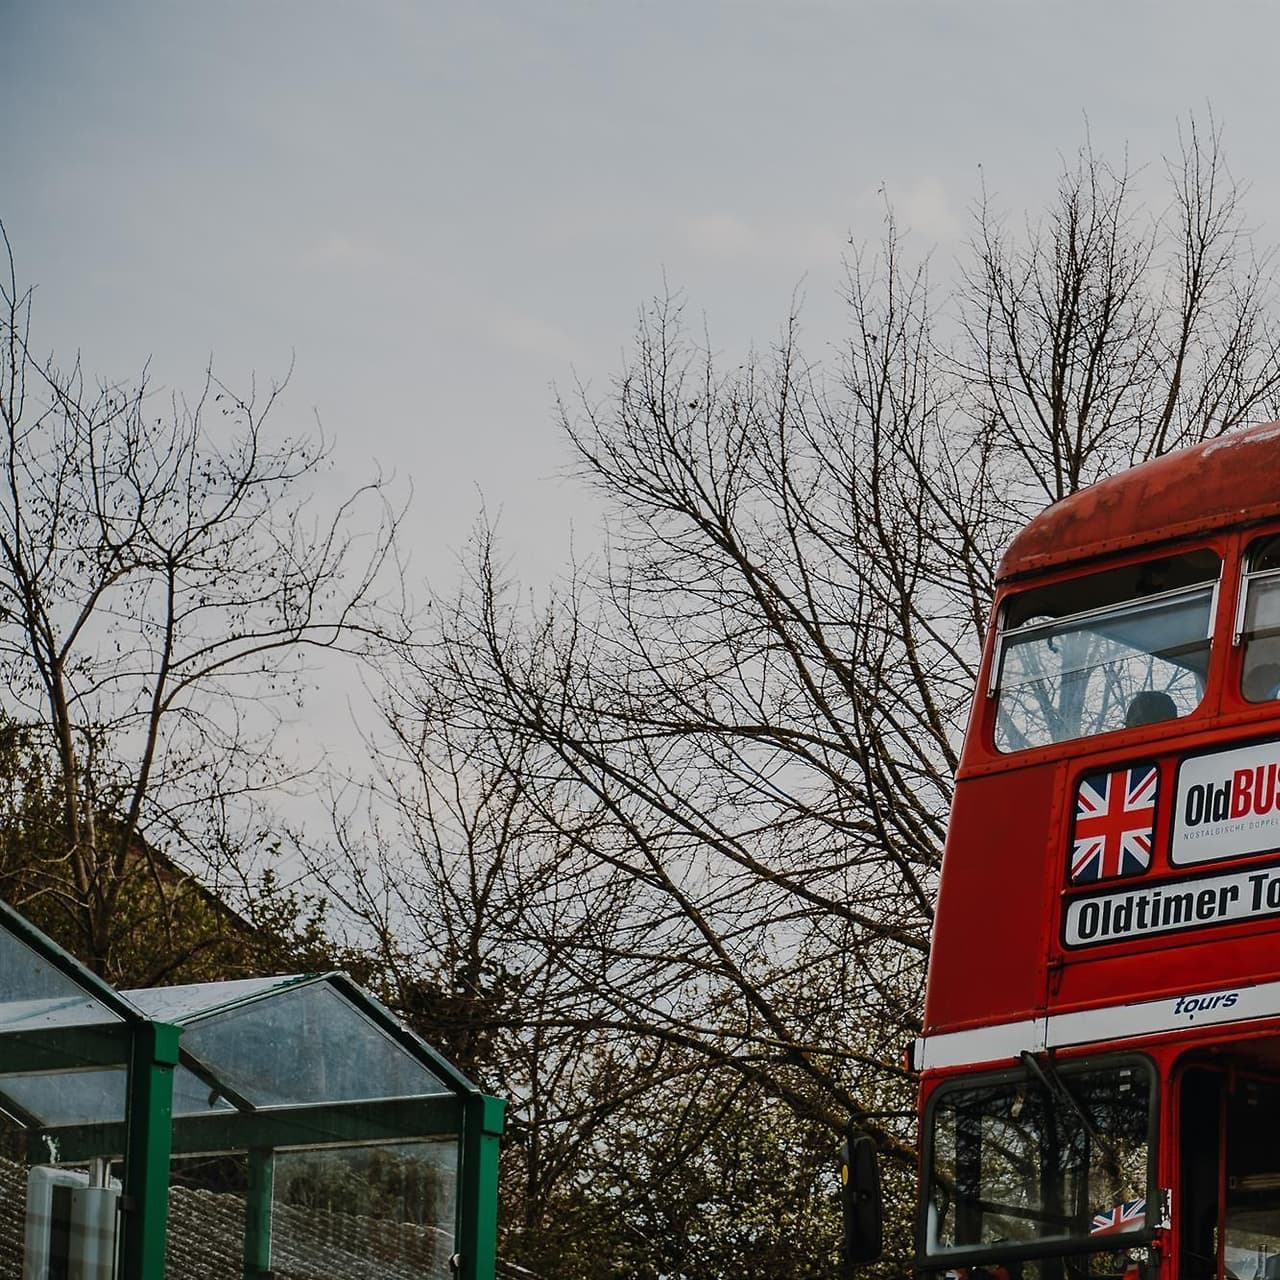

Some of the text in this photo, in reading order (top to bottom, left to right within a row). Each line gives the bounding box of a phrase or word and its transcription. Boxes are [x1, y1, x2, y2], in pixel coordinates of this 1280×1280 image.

[1184, 823, 1245, 841] NOSTALGISCHE
[1077, 884, 1239, 940] Oldtimer
[1174, 990, 1239, 1017] tours
